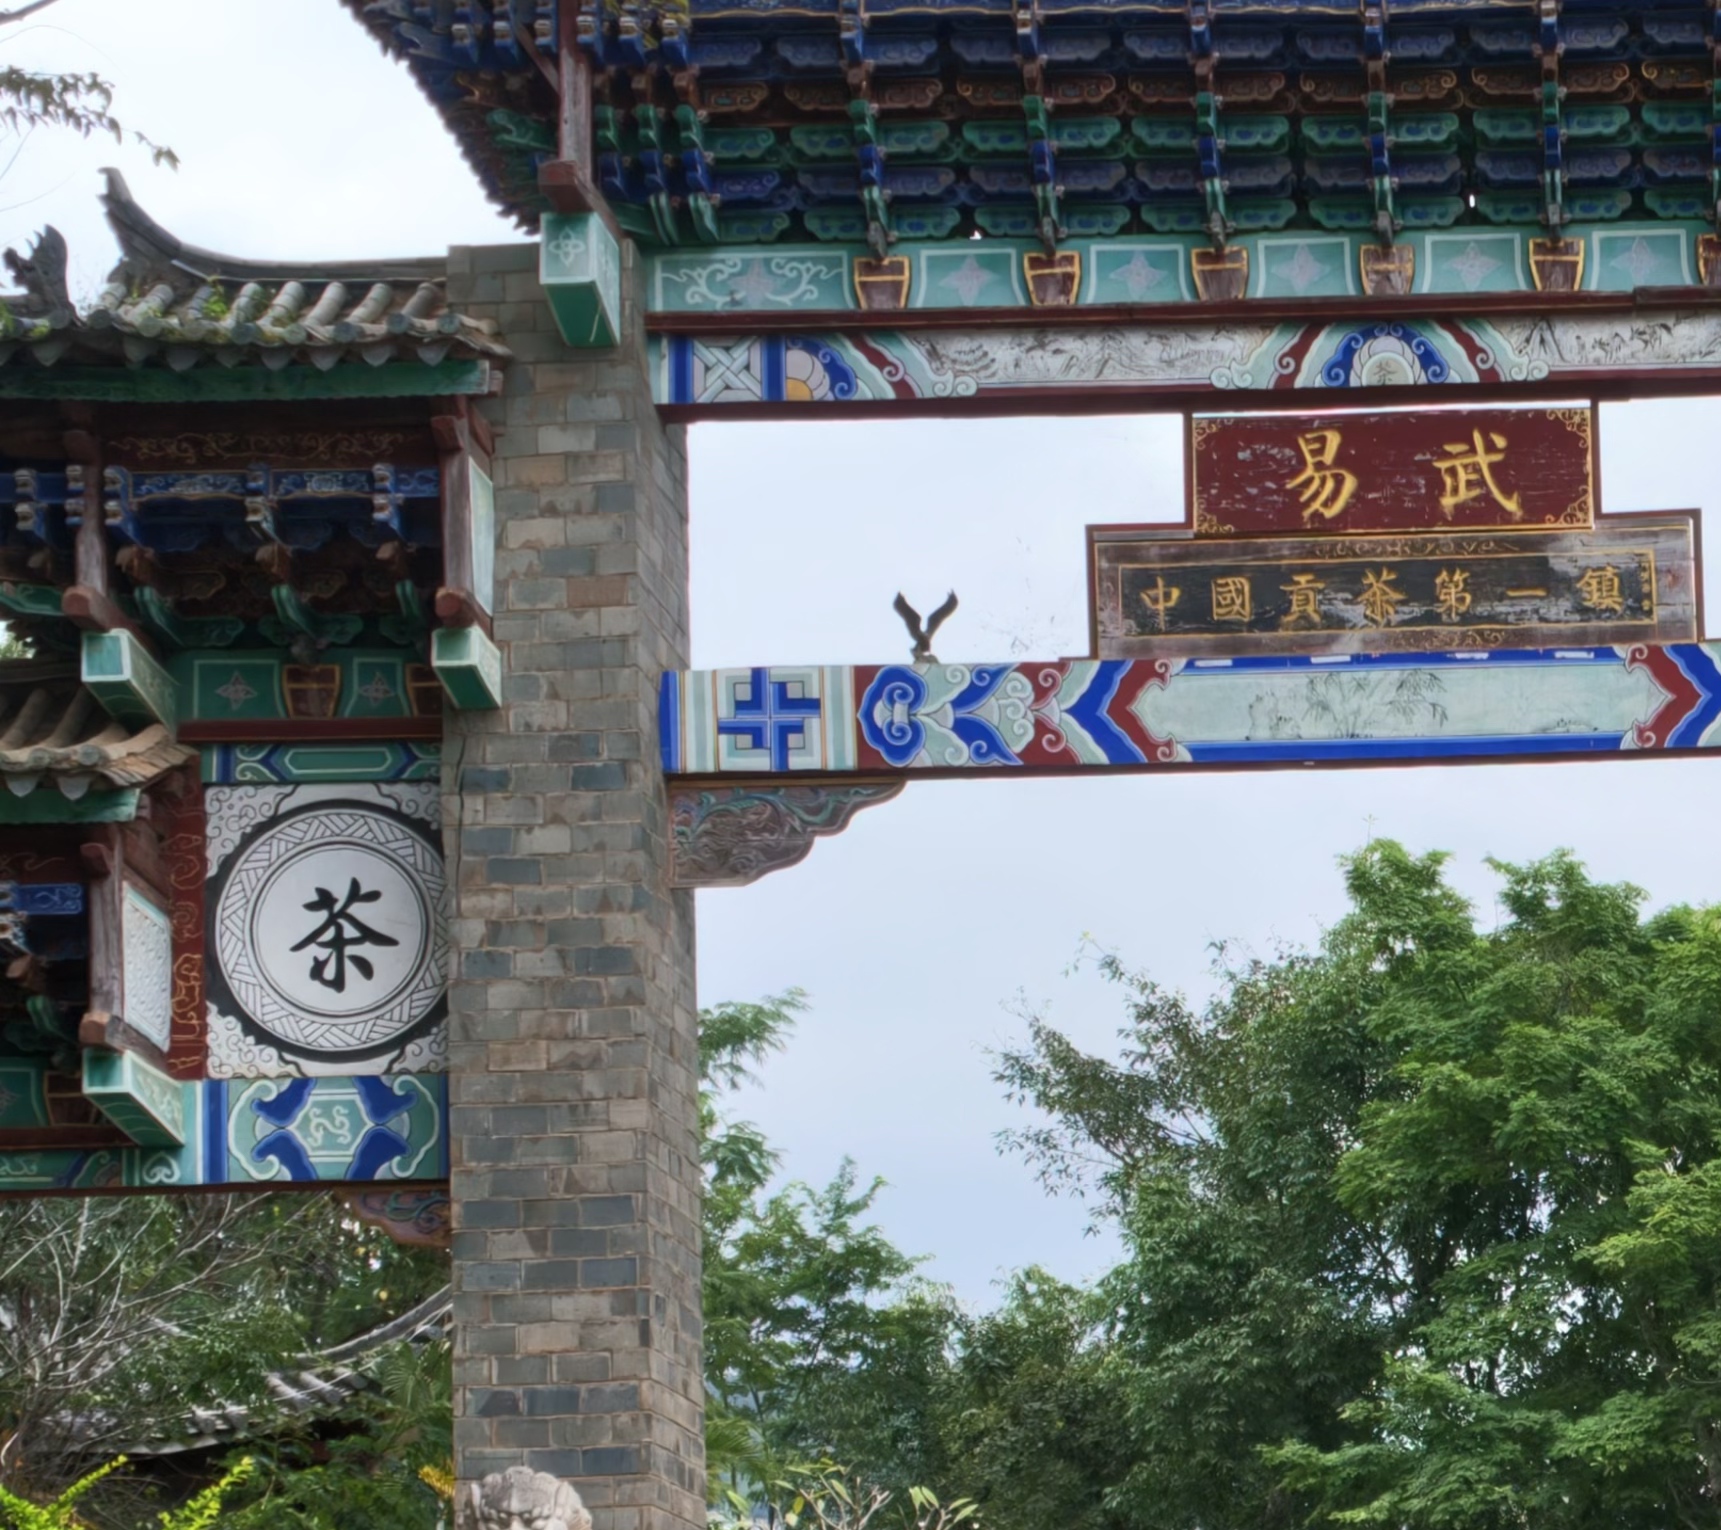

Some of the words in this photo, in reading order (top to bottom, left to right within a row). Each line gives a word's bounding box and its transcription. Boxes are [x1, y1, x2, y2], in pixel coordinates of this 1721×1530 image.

[1286, 426, 1523, 520] 易武
[1139, 563, 1625, 631] 中國貢茶第一鎮
[289, 877, 400, 993] 茶
